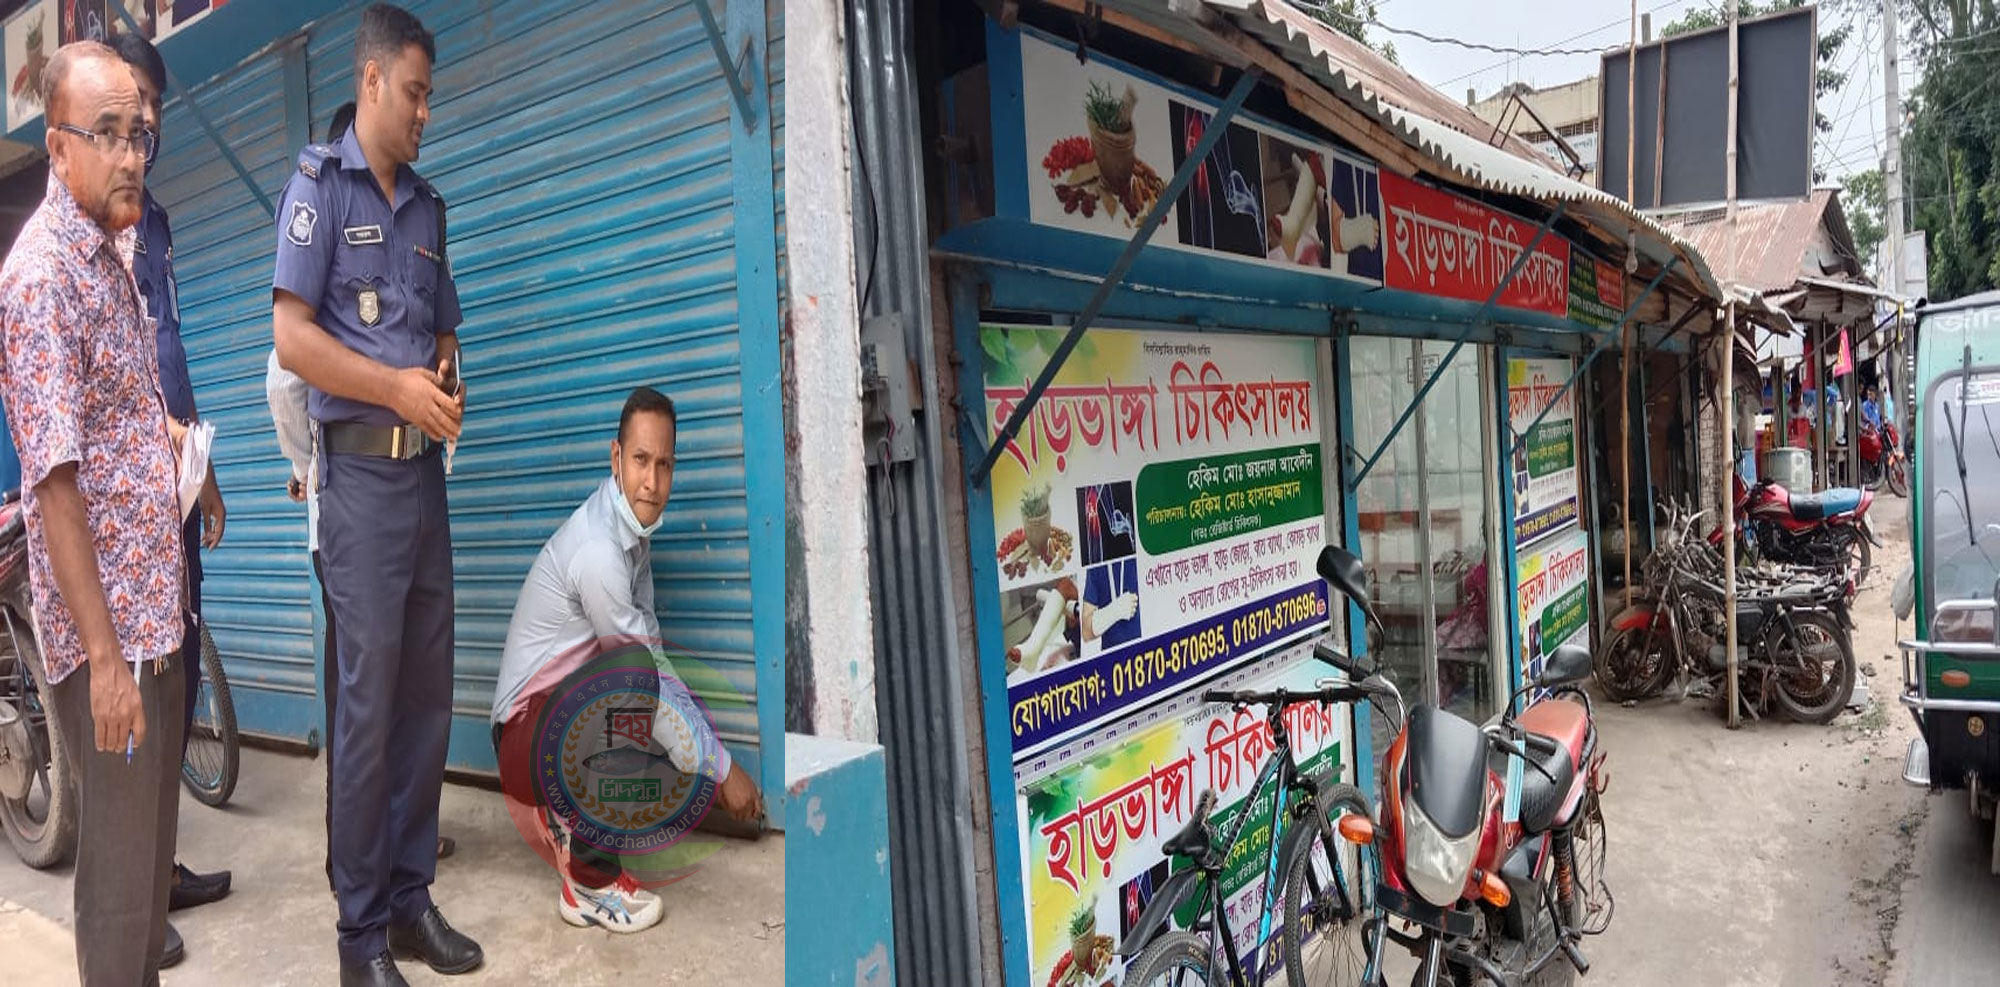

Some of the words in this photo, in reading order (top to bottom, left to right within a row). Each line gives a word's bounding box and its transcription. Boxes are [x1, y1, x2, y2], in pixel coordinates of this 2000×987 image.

[1389, 204, 1484, 287] হাড়ভাঙ্গা
[985, 376, 1158, 475] হাড়ভাঙ্গা
[1168, 361, 1312, 446] চিকিৎসালয়
[1188, 462, 1219, 490] হেকিম
[1223, 464, 1243, 483] মোঃ
[1279, 449, 1313, 473] আবেদীন
[1189, 492, 1222, 520] হেকিম
[1225, 492, 1245, 511] মোঃ
[1112, 624, 1229, 697] 01870-870695,
[1233, 591, 1317, 648] 01870-870696
[1041, 747, 1196, 893] হাড়ভাঙ্গা
